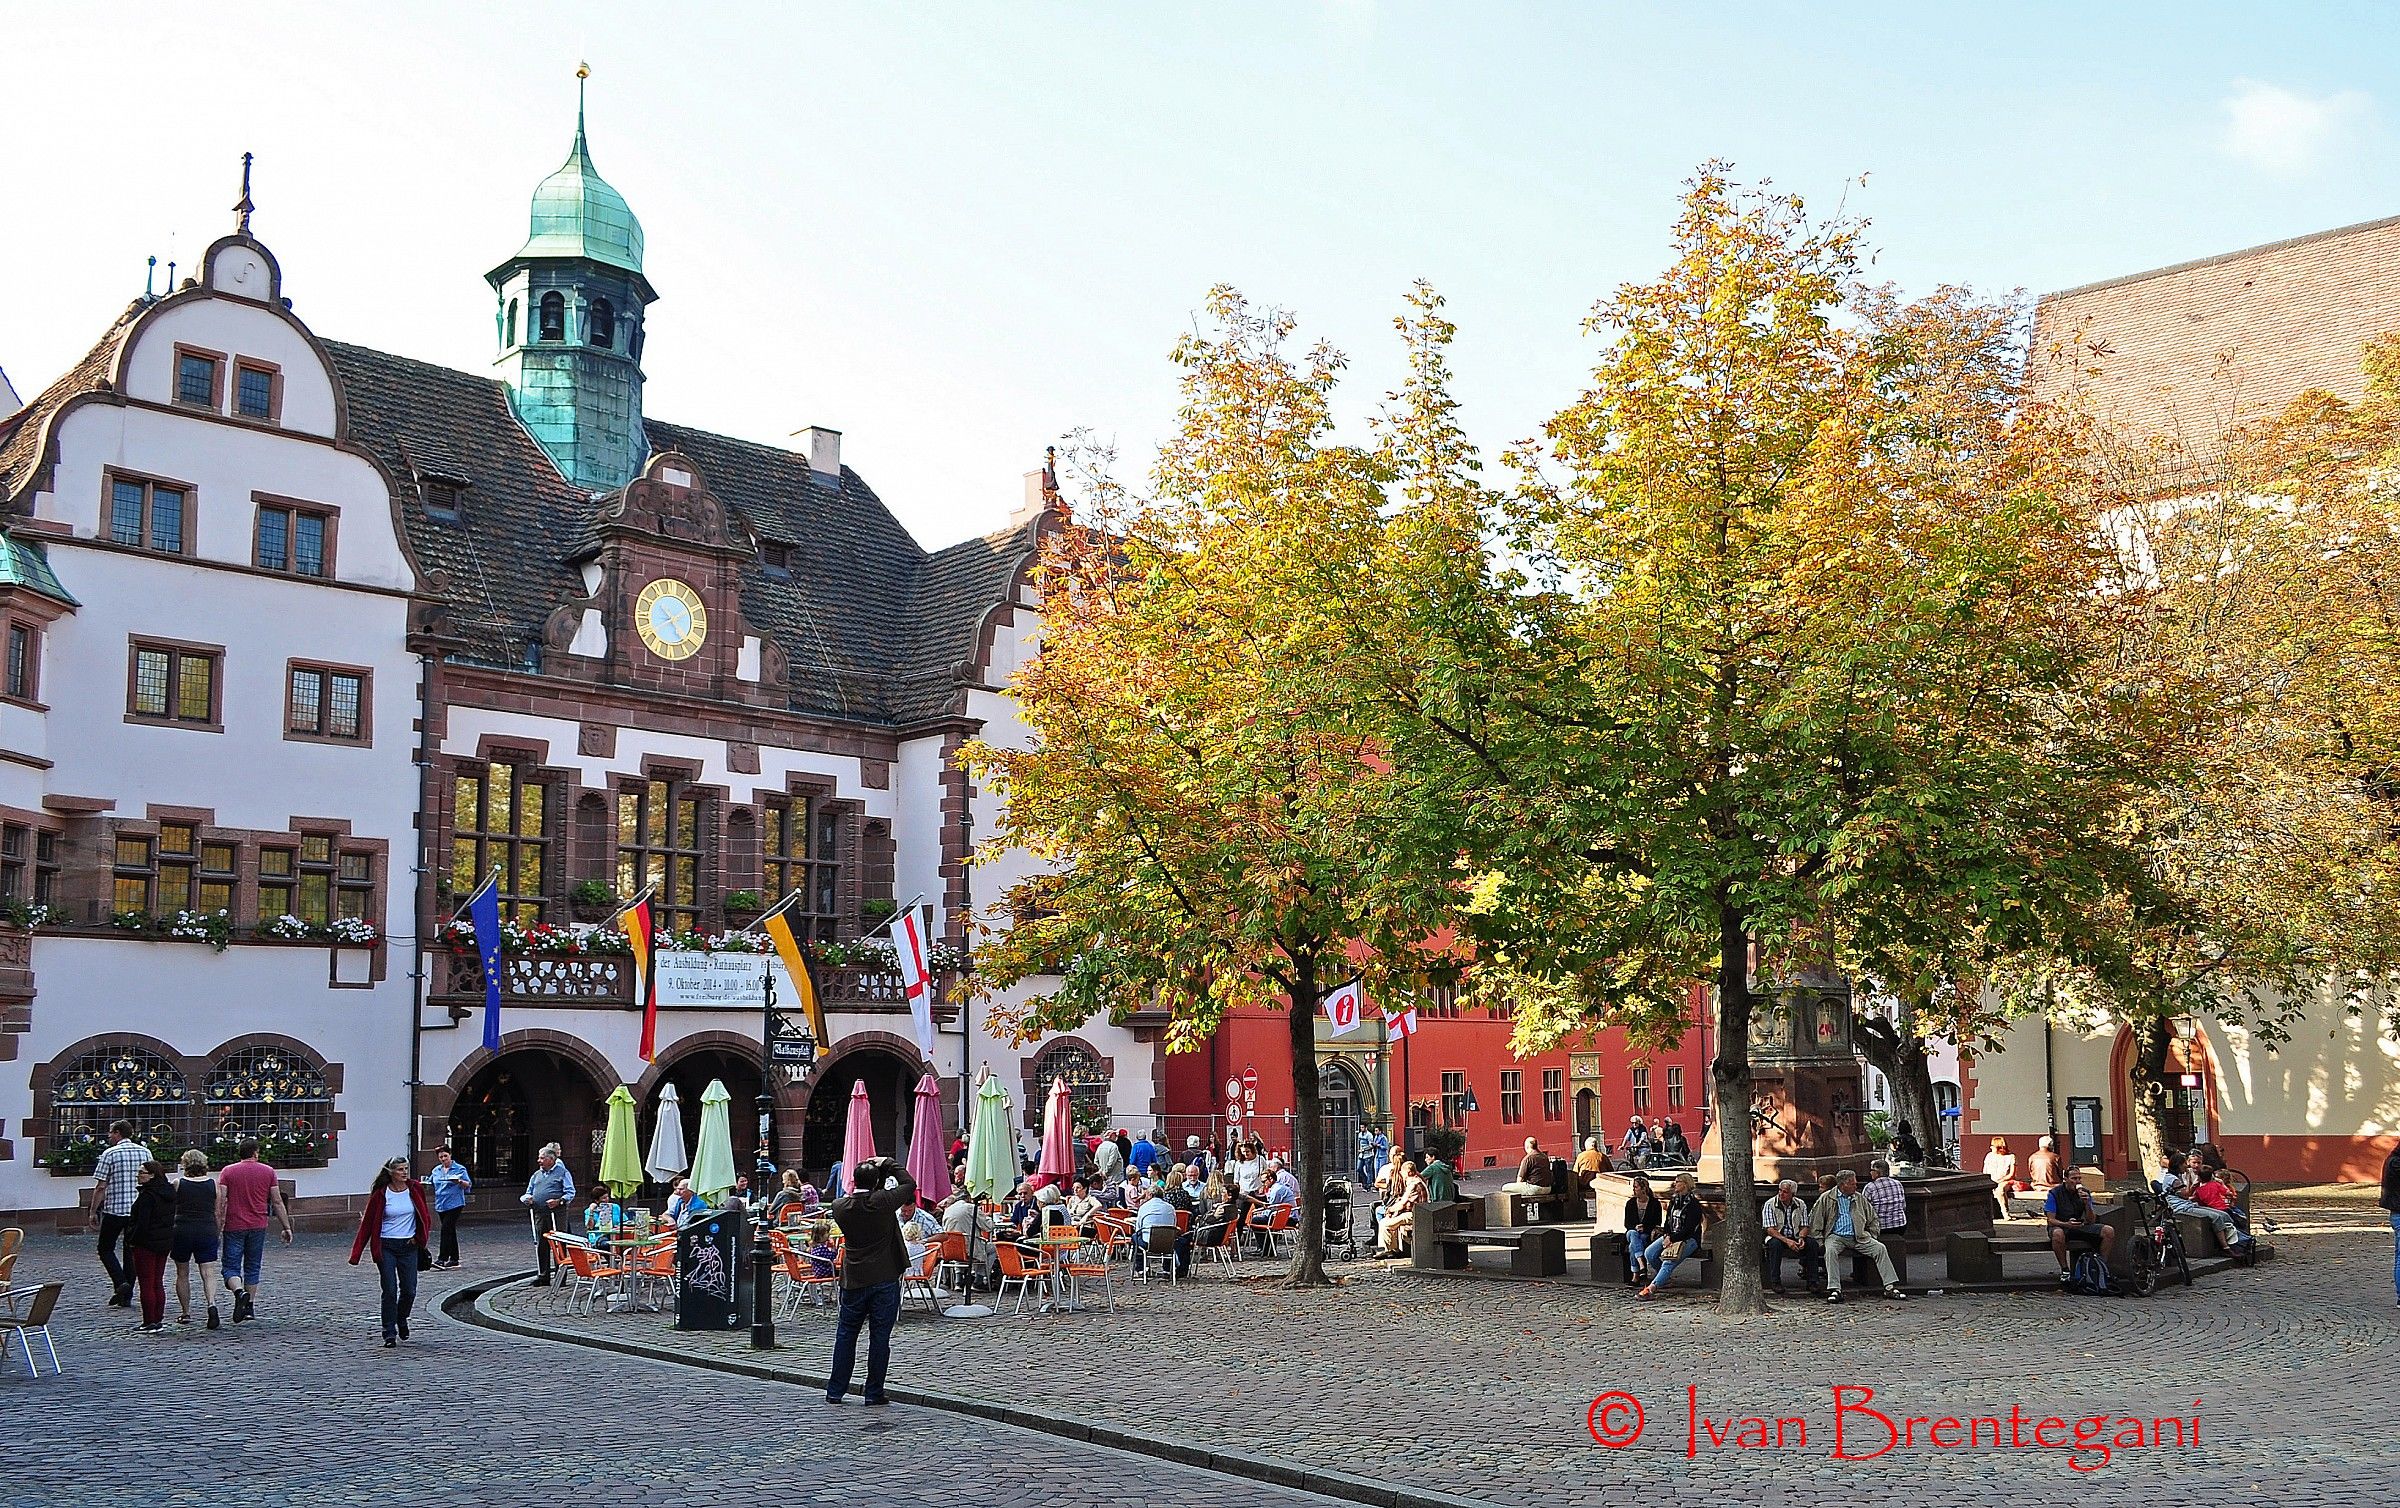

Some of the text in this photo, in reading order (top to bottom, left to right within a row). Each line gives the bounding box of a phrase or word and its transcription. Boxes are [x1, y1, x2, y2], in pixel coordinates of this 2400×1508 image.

[673, 957, 707, 972] Ausbildung
[675, 977, 700, 989] Oktober
[703, 979, 717, 990] 2014
